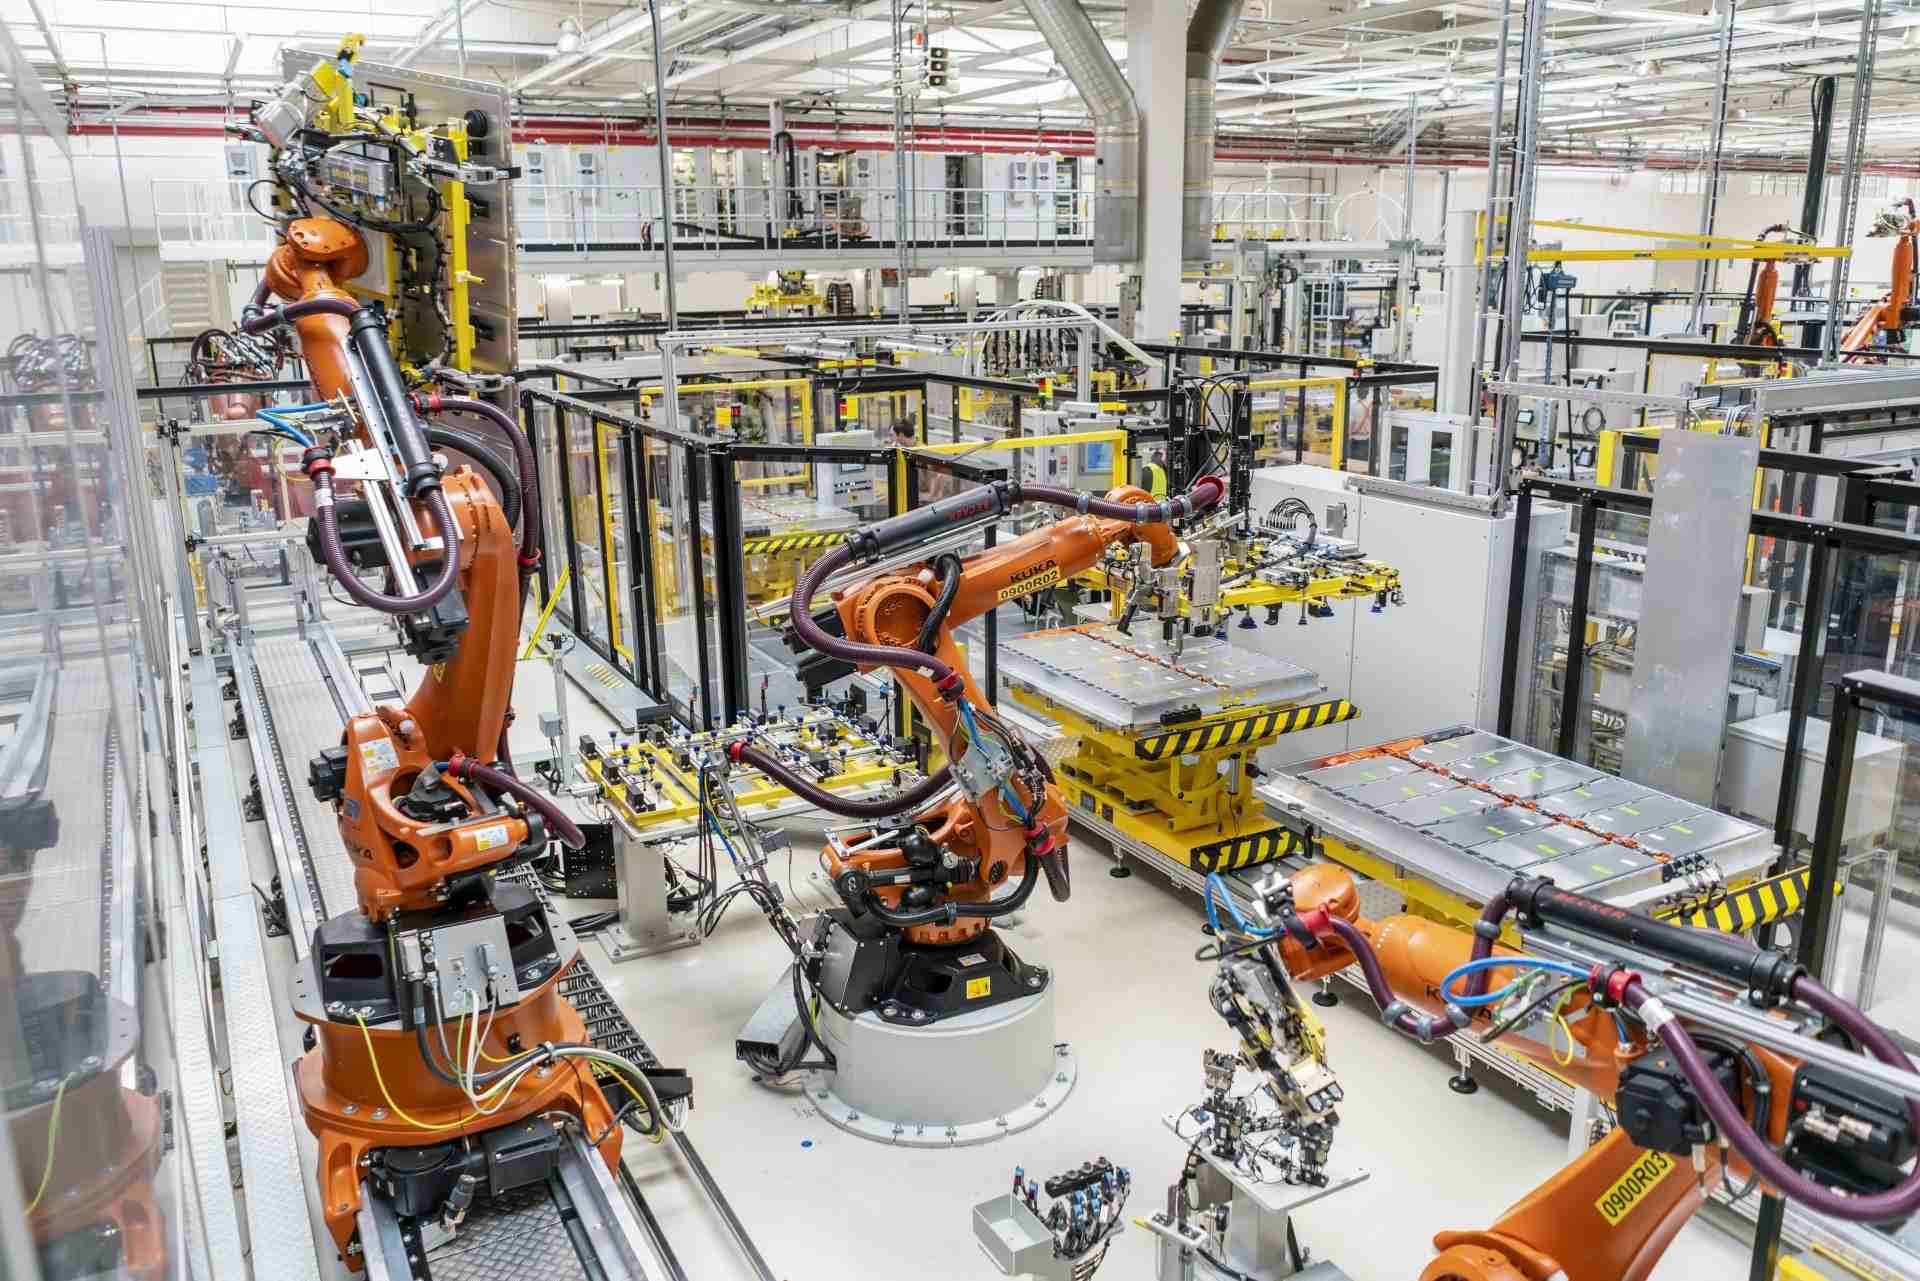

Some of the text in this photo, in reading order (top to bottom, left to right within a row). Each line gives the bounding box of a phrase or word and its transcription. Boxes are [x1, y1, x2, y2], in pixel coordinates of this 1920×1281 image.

[1001, 571, 1058, 598] 0900R02
[1010, 559, 1057, 583] KUKA
[1425, 984, 1492, 1020] KA
[1602, 1151, 1668, 1218] 0900R03
